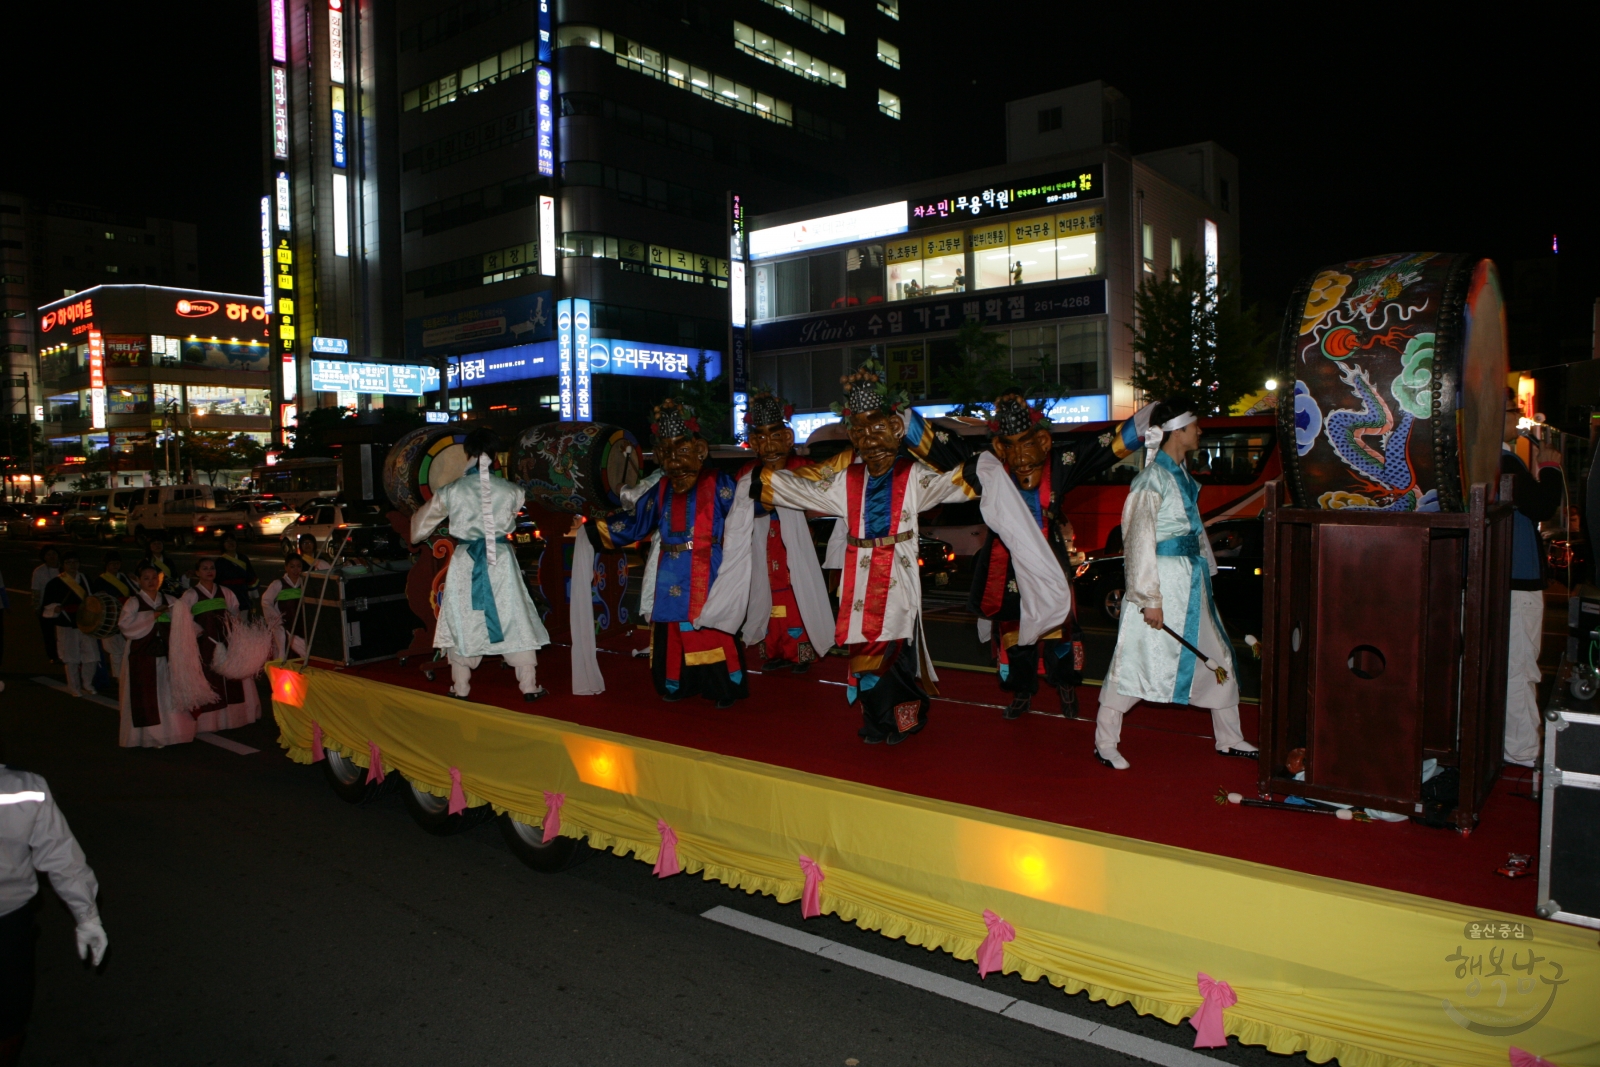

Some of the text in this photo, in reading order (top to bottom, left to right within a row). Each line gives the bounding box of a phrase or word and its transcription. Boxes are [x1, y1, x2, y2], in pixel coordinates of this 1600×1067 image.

[334, 112, 344, 163] 한국화장품
[914, 199, 948, 217] 차소민
[956, 189, 1009, 215] 무용학원
[1015, 221, 1050, 240] 한국무용
[58, 298, 93, 325] 하이마트
[800, 295, 1090, 344] Kim's 수입 가구 백화점 261-4268
[427, 359, 485, 386] 우투자증권
[612, 346, 688, 373] 우리투자증권
[560, 334, 570, 418] 우리투자증권
[577, 334, 589, 418] 우리투자증권
